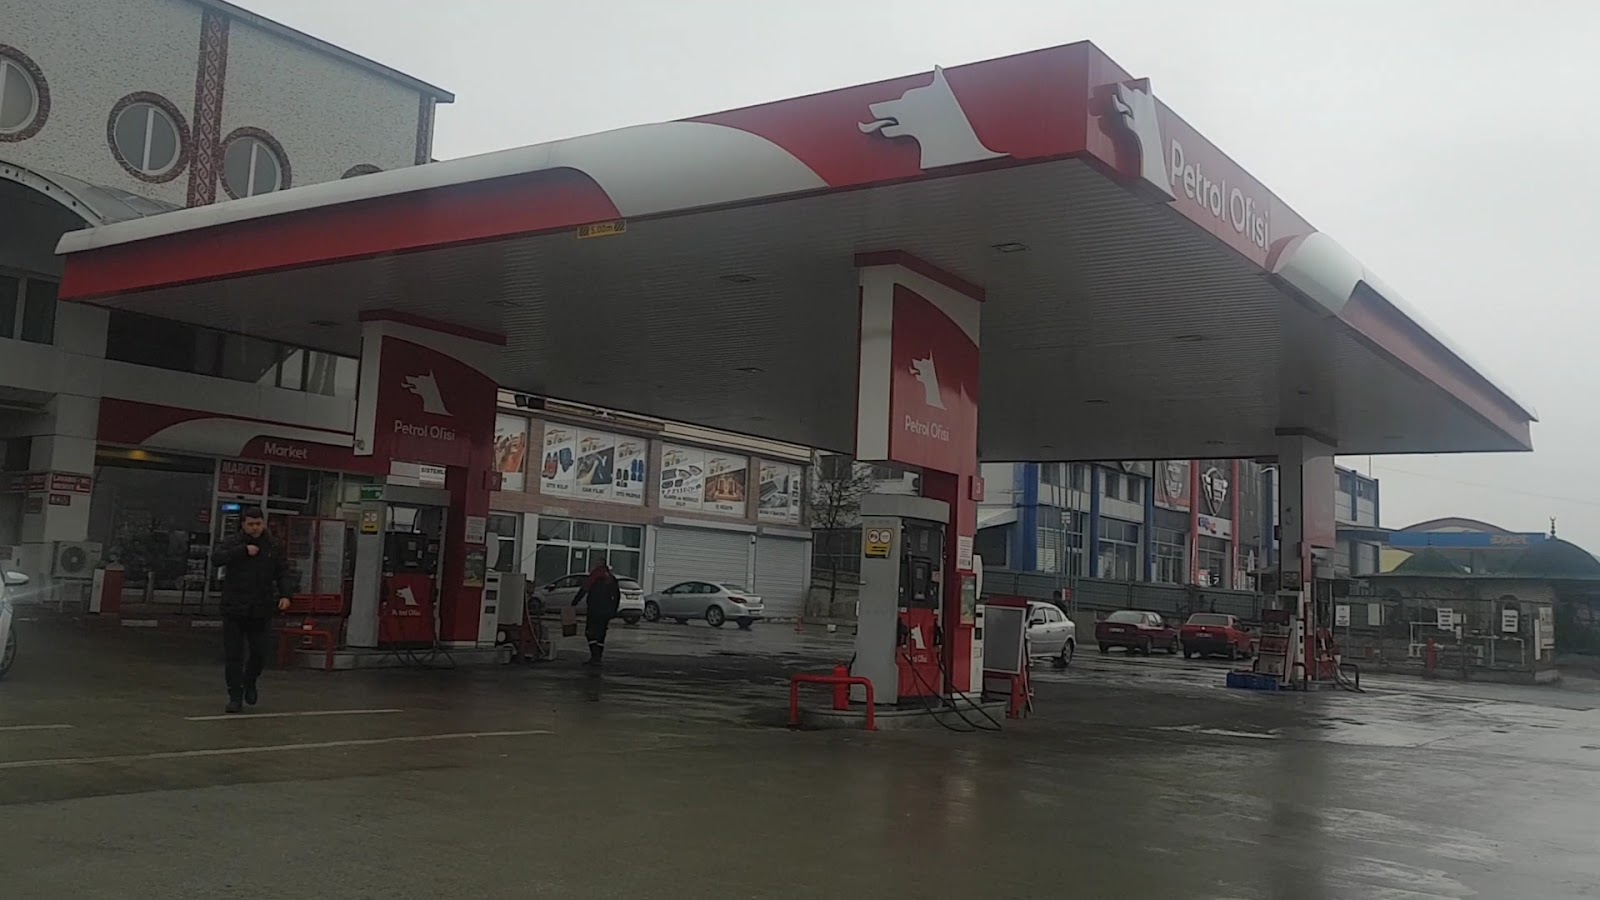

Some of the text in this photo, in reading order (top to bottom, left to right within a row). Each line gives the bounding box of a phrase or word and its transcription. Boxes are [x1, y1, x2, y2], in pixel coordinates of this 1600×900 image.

[1170, 138, 1269, 252] Petrol Ofisi
[394, 419, 456, 441] Petrol Ofisi
[904, 414, 950, 442] Petrol Ofisi
[264, 441, 307, 459] Market
[222, 461, 265, 476] MARKET
